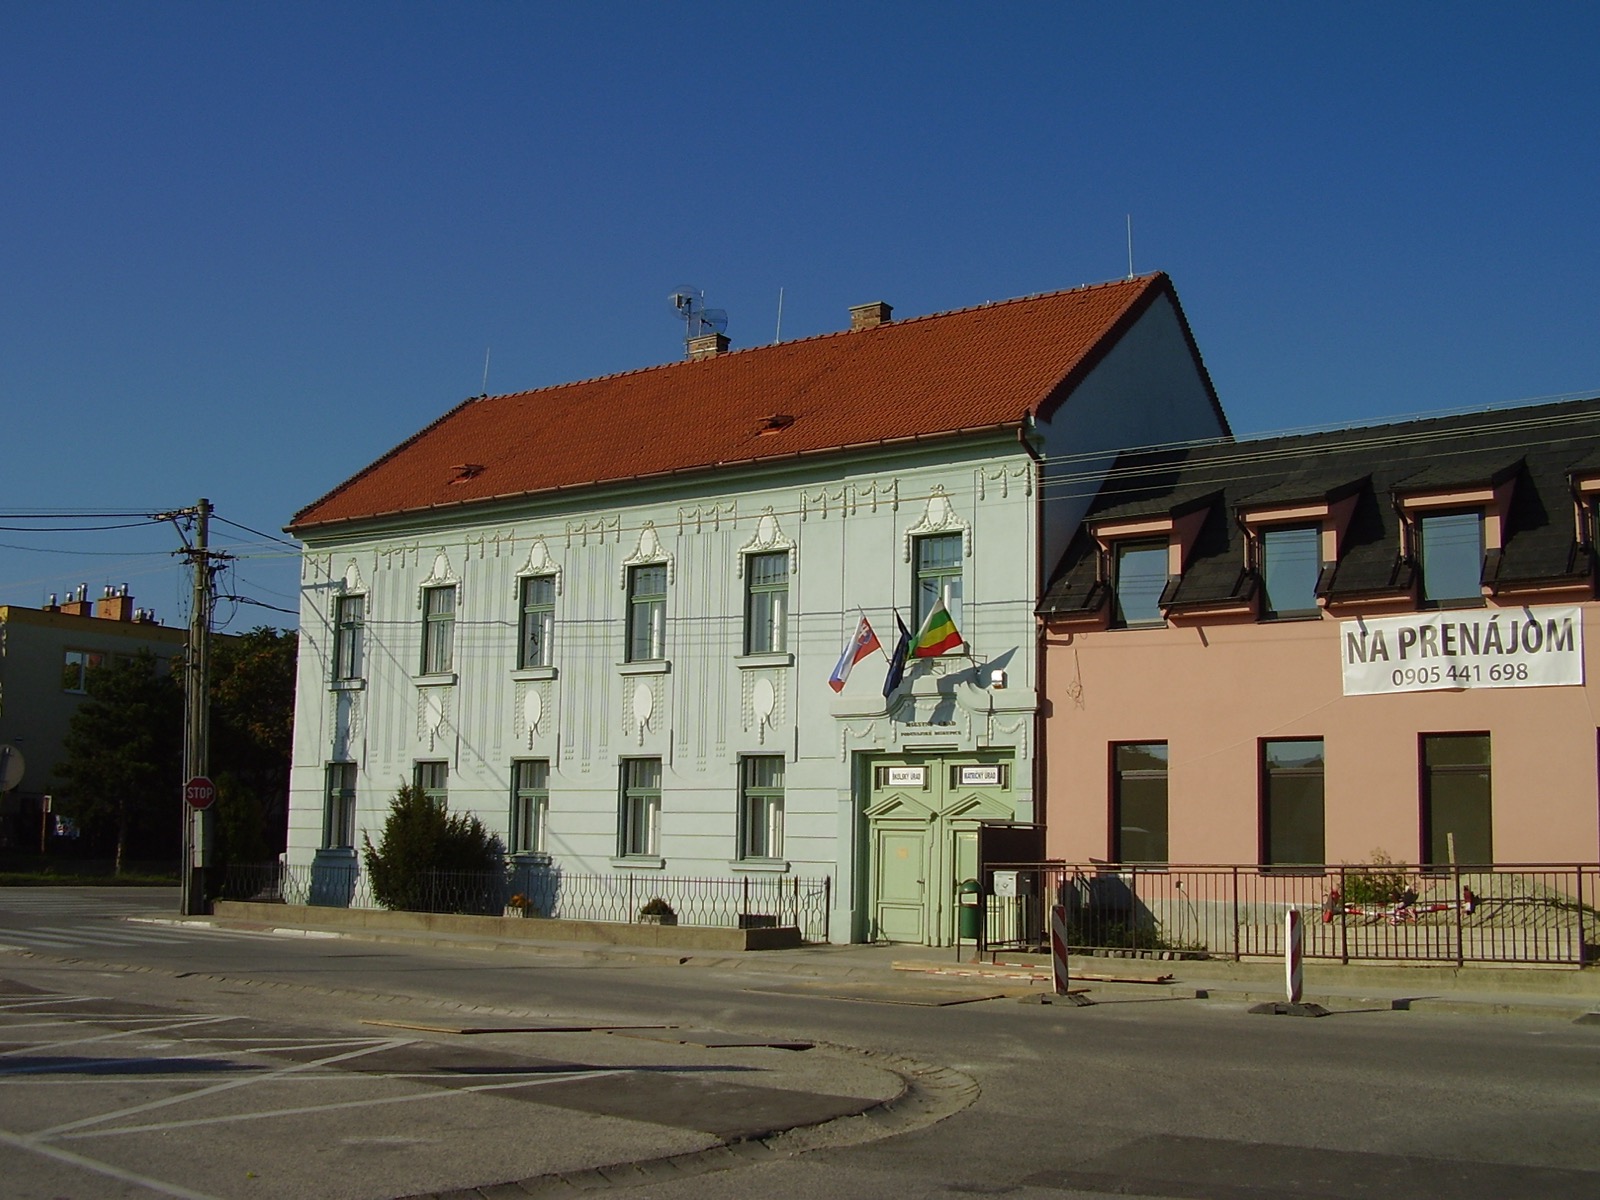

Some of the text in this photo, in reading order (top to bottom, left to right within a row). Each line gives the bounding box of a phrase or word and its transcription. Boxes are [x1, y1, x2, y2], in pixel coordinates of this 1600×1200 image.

[1347, 615, 1574, 664] NA PRENÁJOM
[1392, 663, 1528, 686] 0905 441 698
[187, 786, 213, 799] STOP
